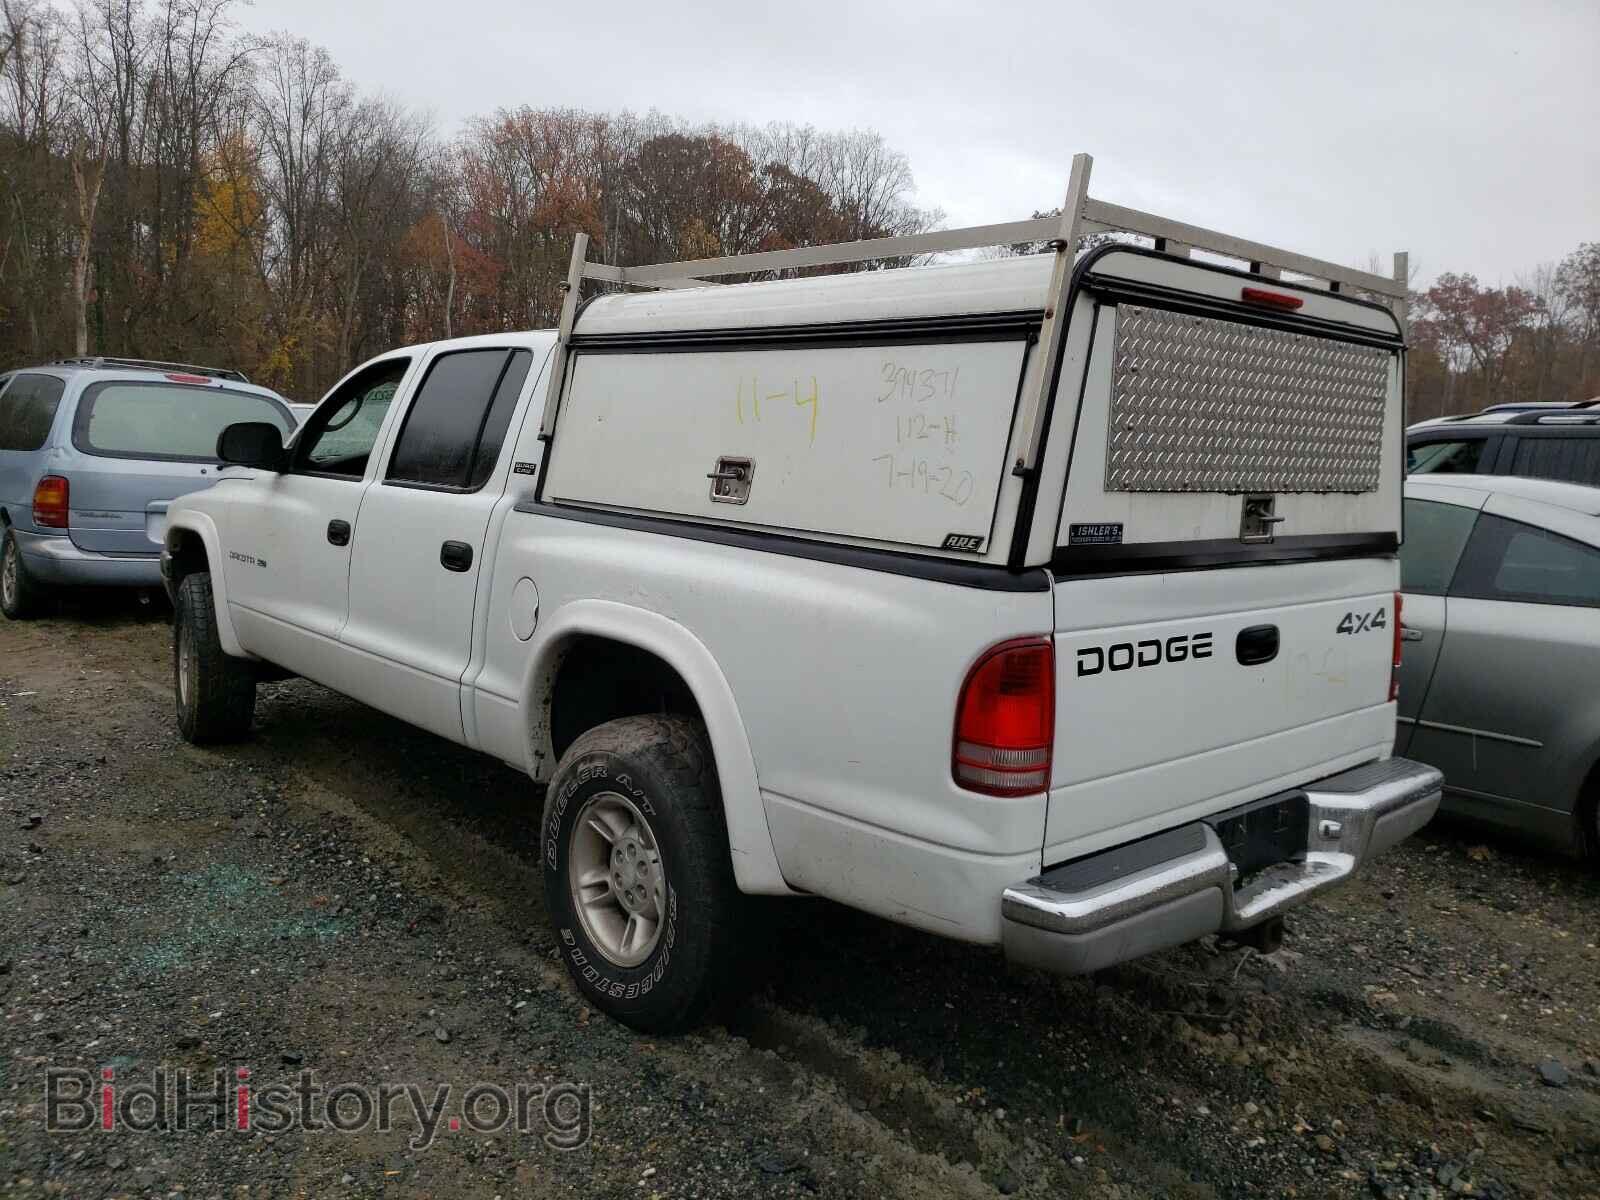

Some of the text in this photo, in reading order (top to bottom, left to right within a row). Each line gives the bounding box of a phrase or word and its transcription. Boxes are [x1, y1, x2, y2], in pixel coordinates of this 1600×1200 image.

[736, 375, 818, 446] 11-4
[872, 454, 975, 506] 7-19-20
[1077, 632, 1213, 678] DODGE
